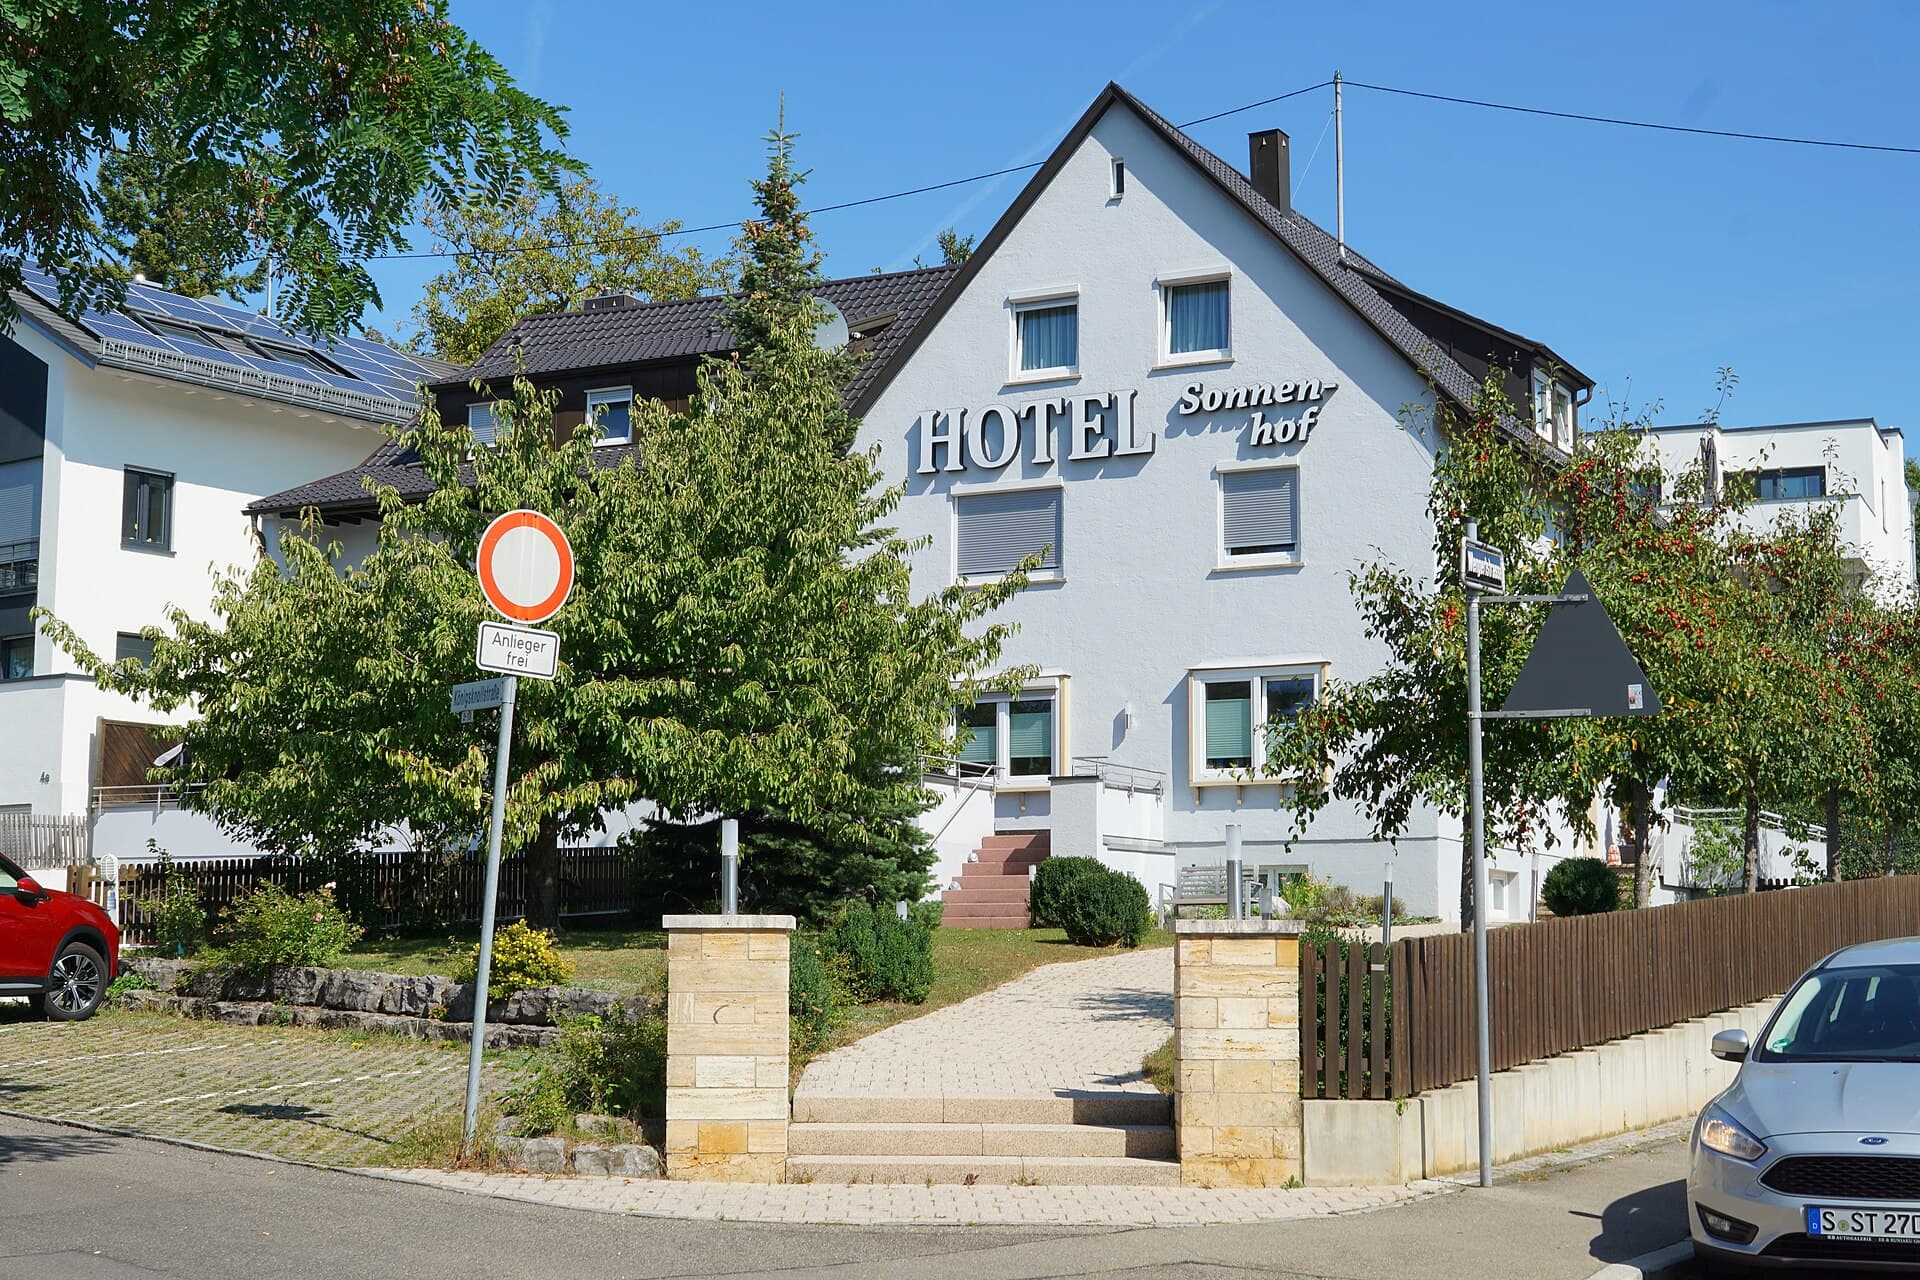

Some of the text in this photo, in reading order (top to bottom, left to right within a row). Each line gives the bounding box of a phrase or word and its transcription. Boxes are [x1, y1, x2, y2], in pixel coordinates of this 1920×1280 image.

[916, 377, 1339, 474] HOTEL Sonnen-
[1250, 406, 1320, 447] hof
[491, 631, 547, 654] Anlieger
[506, 651, 529, 668] frei
[1822, 1211, 1836, 1231] S
[1851, 1212, 1878, 1233] ST
